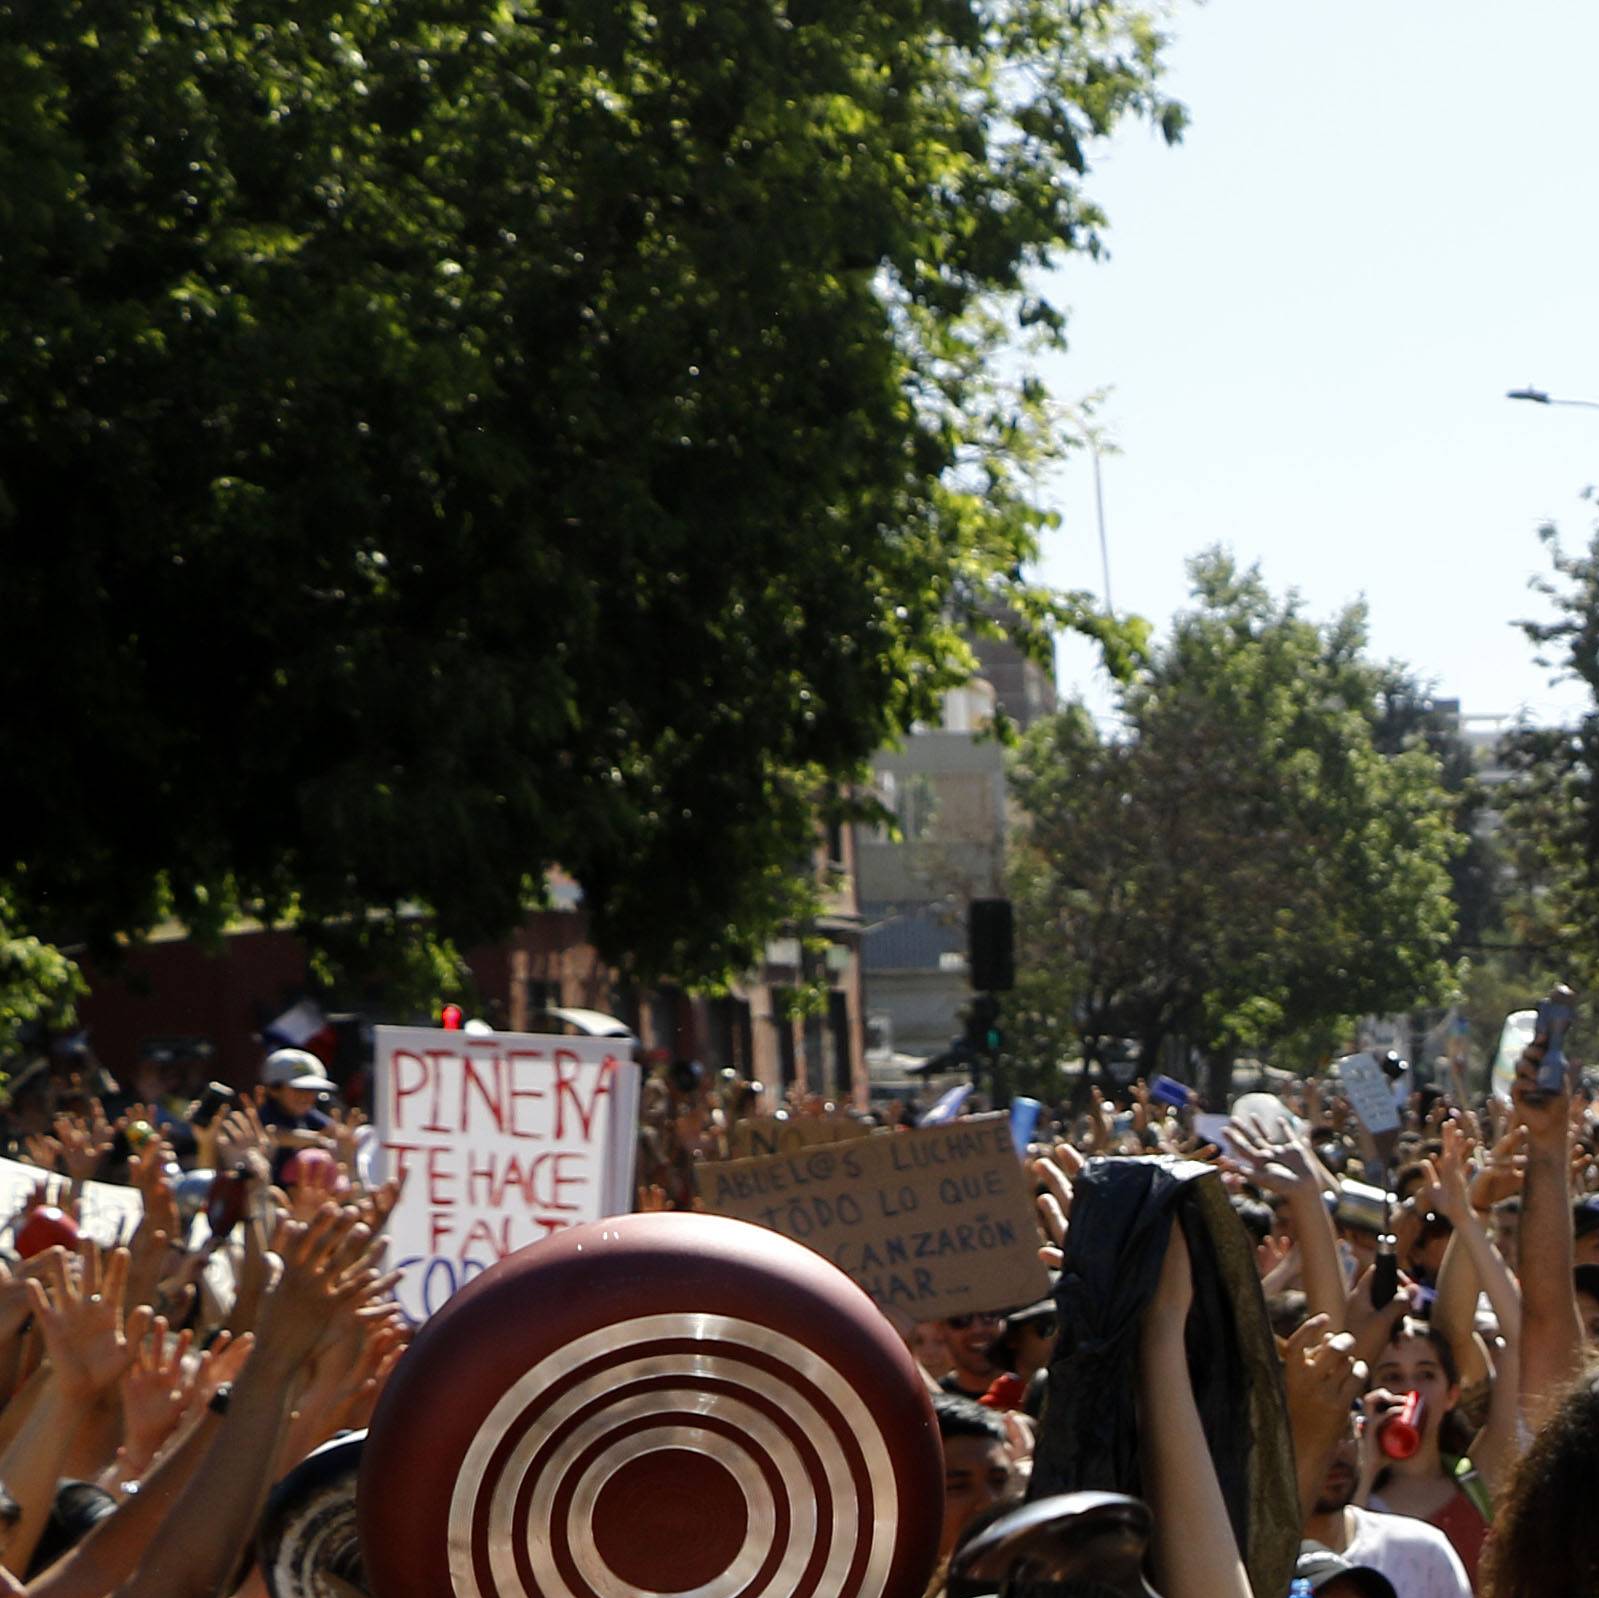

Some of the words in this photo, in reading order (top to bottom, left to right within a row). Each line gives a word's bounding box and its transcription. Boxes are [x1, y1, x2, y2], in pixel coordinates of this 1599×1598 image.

[391, 1040, 619, 1142] PIÑERA
[383, 1142, 454, 1206] TE
[467, 1152, 589, 1211] HACE
[881, 1184, 919, 1217] LO
[938, 1170, 1005, 1206] QUE
[429, 1210, 588, 1260] FALT
